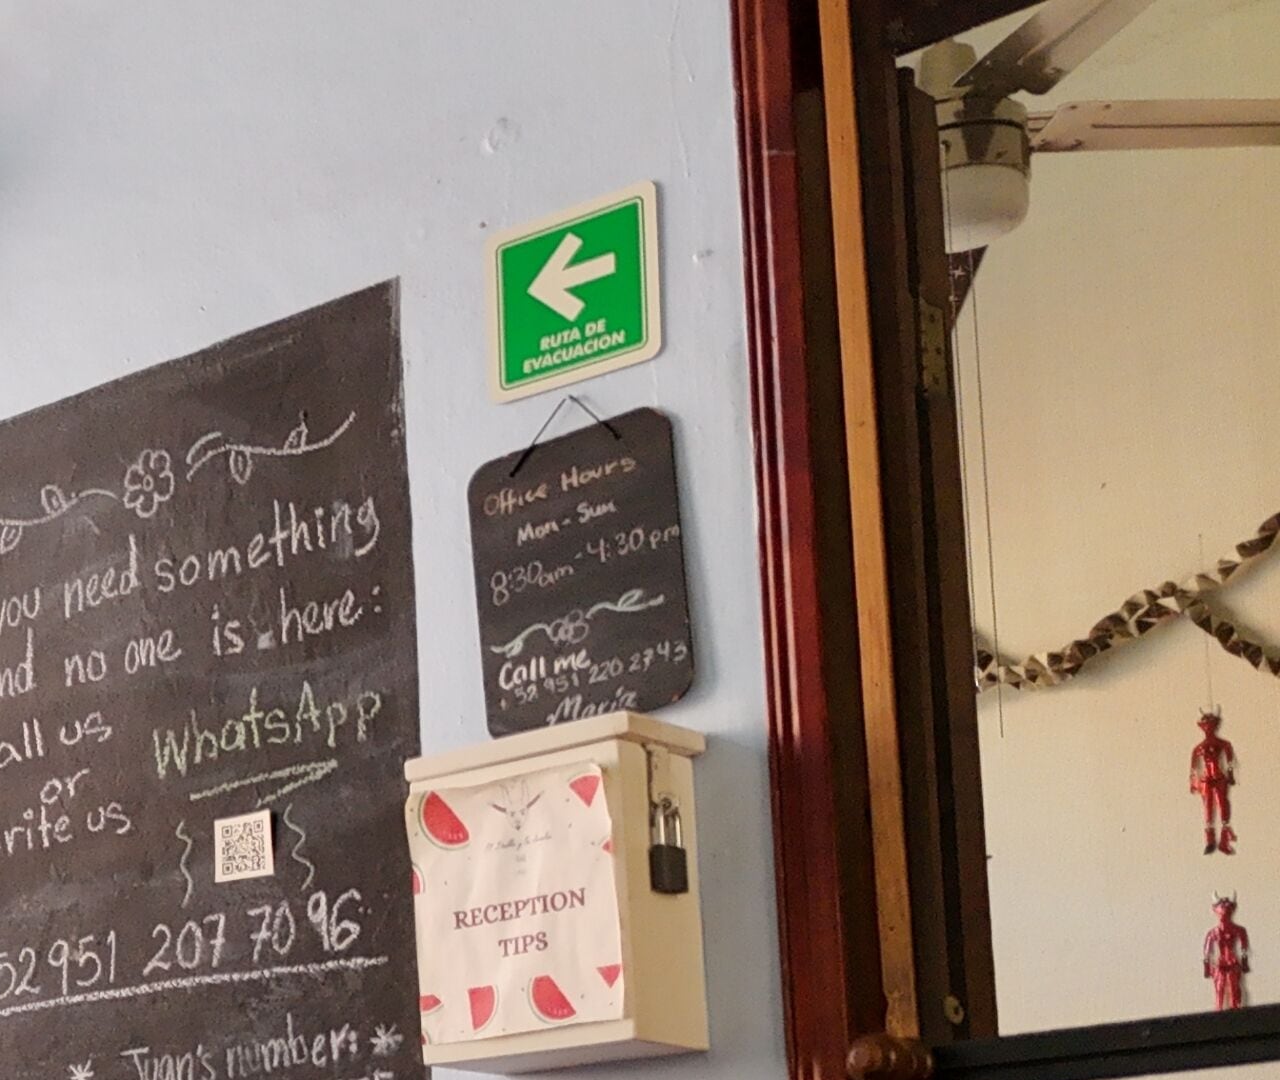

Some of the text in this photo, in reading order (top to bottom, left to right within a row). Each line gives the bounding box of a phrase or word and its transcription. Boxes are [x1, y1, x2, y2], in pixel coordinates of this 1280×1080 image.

[522, 330, 626, 373] EVACUACION
[540, 318, 606, 351] RUTA DE
[485, 457, 636, 515] Office Hours
[64, 534, 139, 618] need
[155, 498, 380, 593] something
[65, 649, 107, 686] no
[124, 629, 182, 675] one
[211, 604, 244, 656] is
[499, 649, 590, 690] Call me
[60, 711, 112, 745] us
[152, 680, 383, 779] WhatsApp
[40, 769, 91, 804] or
[86, 801, 132, 834] us
[453, 887, 587, 930] RECEPTION
[143, 913, 226, 976] 207
[498, 931, 549, 958] TIPS
